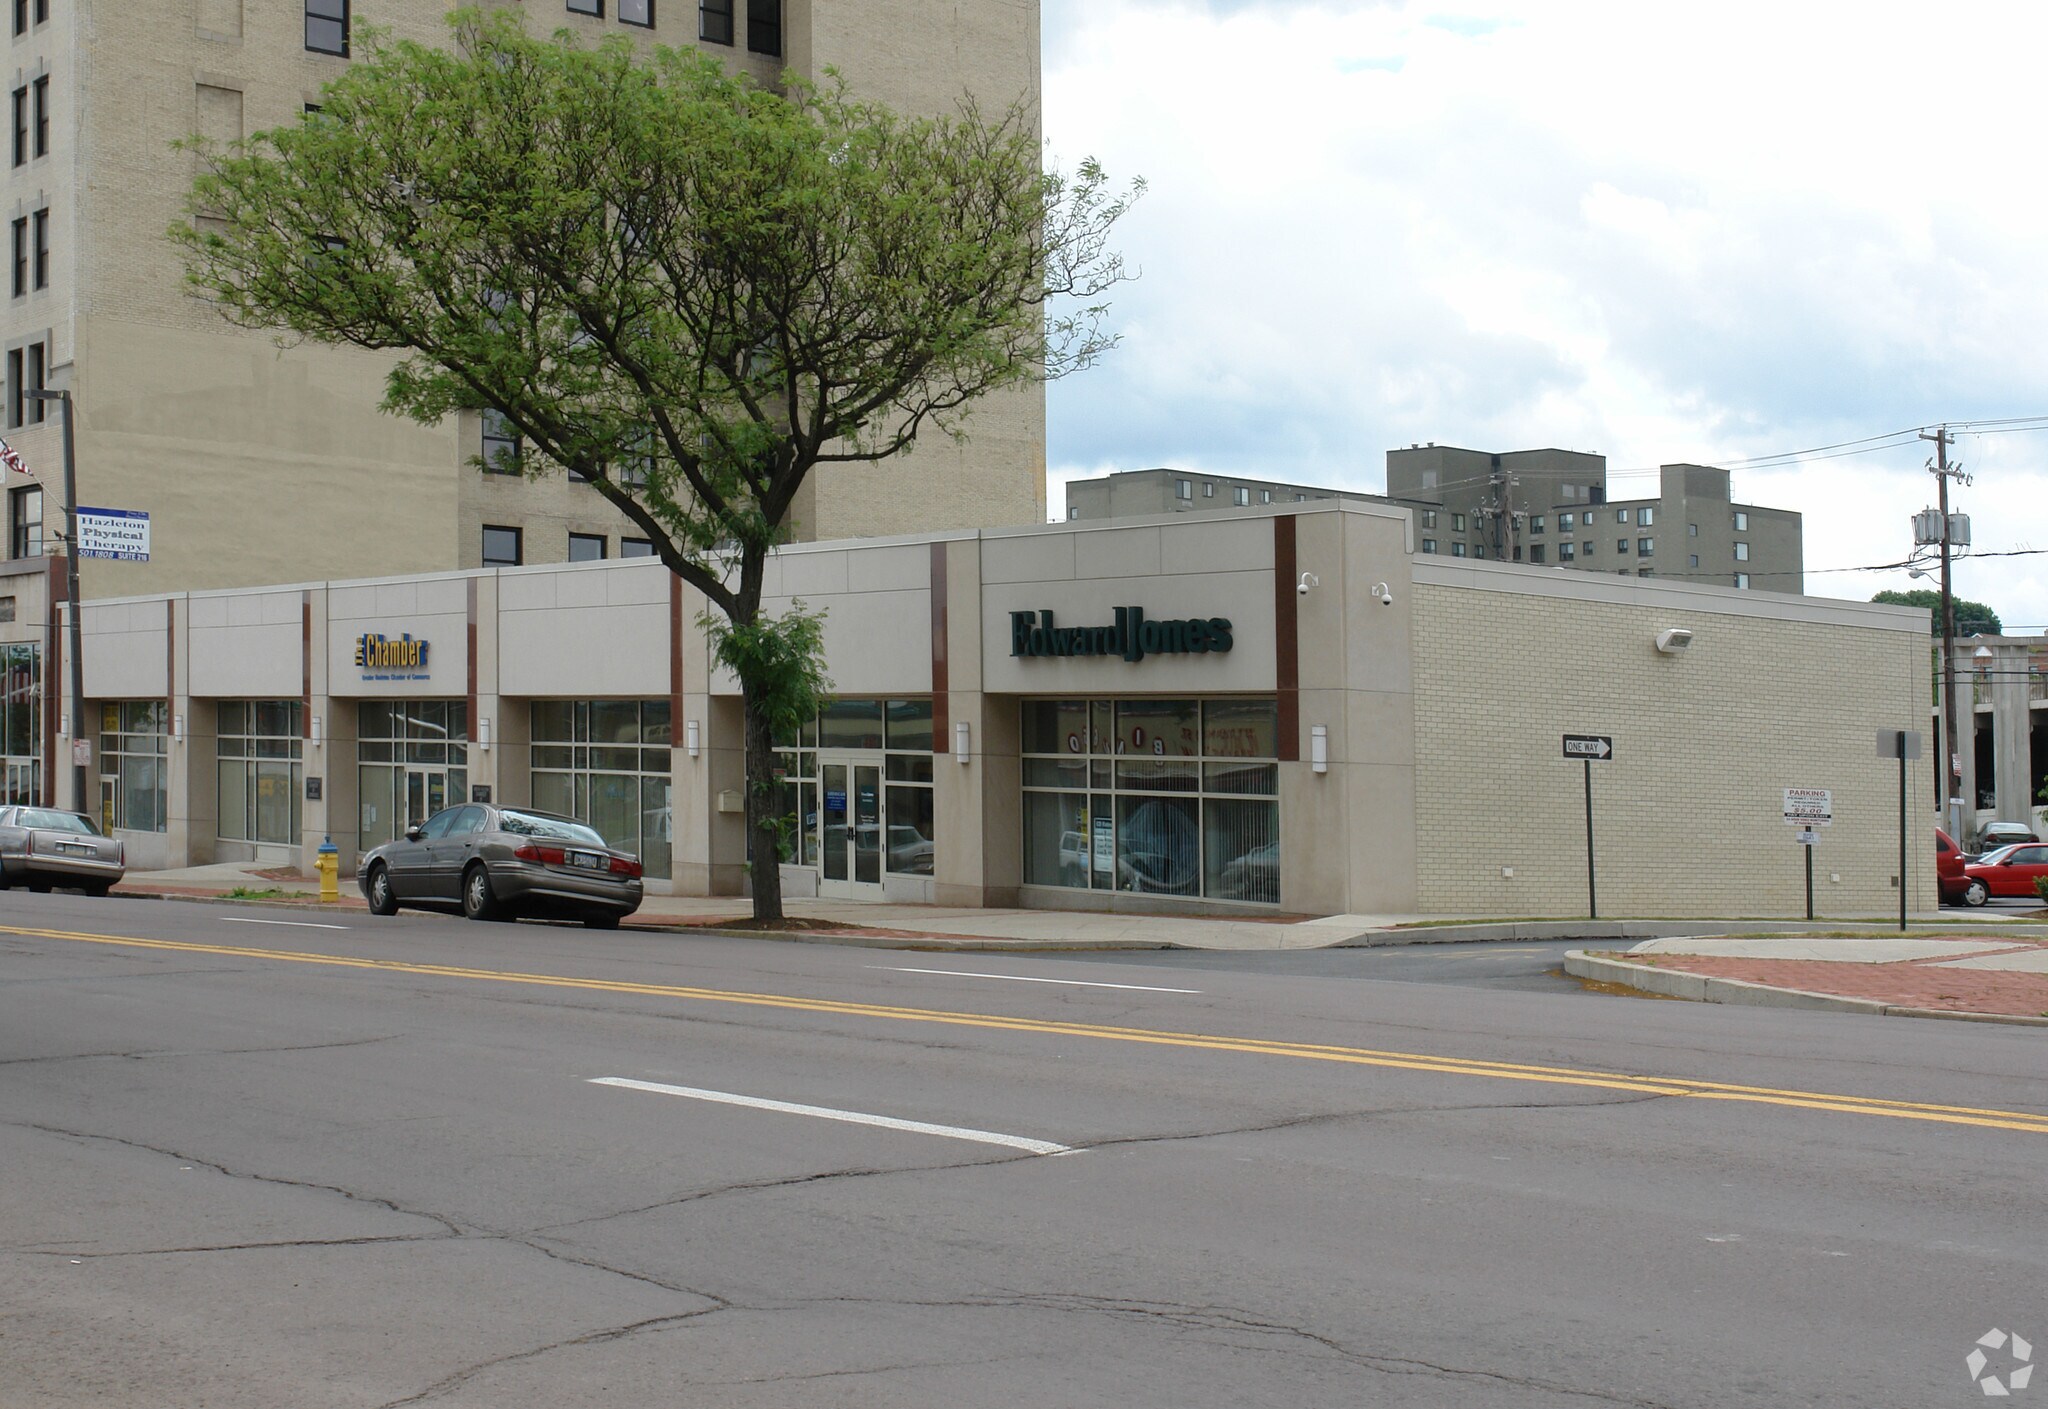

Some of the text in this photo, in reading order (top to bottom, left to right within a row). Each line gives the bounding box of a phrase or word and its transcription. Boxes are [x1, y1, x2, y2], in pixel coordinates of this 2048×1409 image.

[81, 517, 145, 530] Hazleton
[82, 527, 144, 540] Physical
[81, 539, 144, 552] Therapy
[1008, 606, 1234, 662] Edward Jones
[364, 633, 430, 667] Chamber
[1567, 741, 1598, 752] ONE WAY
[1789, 789, 1825, 797] PARKING
